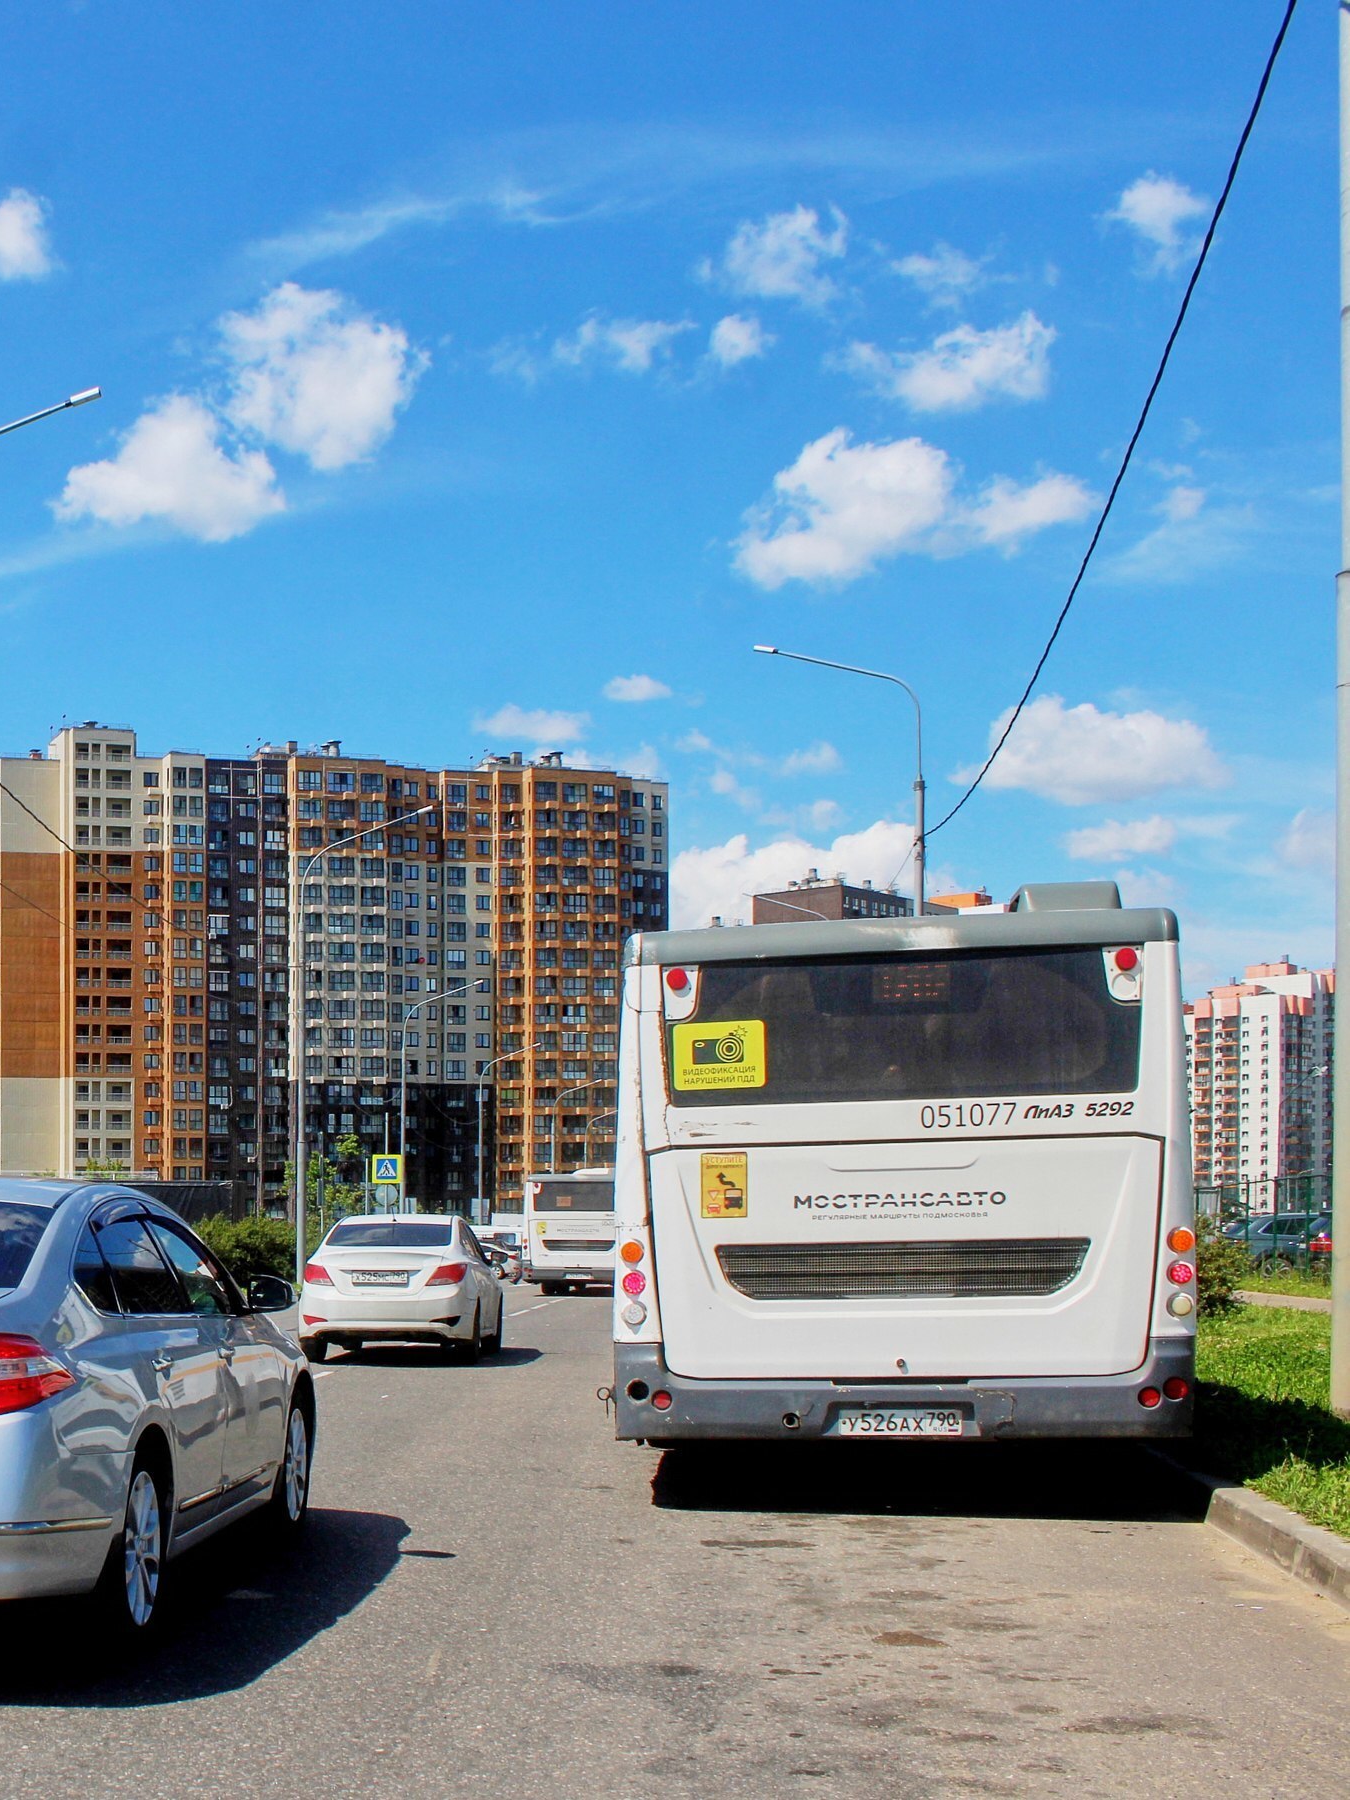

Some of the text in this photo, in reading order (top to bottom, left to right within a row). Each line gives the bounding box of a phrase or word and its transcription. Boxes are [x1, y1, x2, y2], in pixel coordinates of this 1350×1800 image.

[682, 1065, 756, 1076] ВИДЕОФИКСАЦИЯ
[683, 1075, 755, 1085] НАРУШЕНИЙ ПДД
[921, 1102, 1017, 1129] 051077
[1084, 1100, 1135, 1117] 5292
[793, 1191, 1007, 1209] МОСТРАНСАВТО
[811, 1211, 989, 1221] РЕГУЛЯРНЫЕ МАРШРУТЫ ПОДМОСКОВЬЯ
[848, 1411, 957, 1433] У526АХ 790
